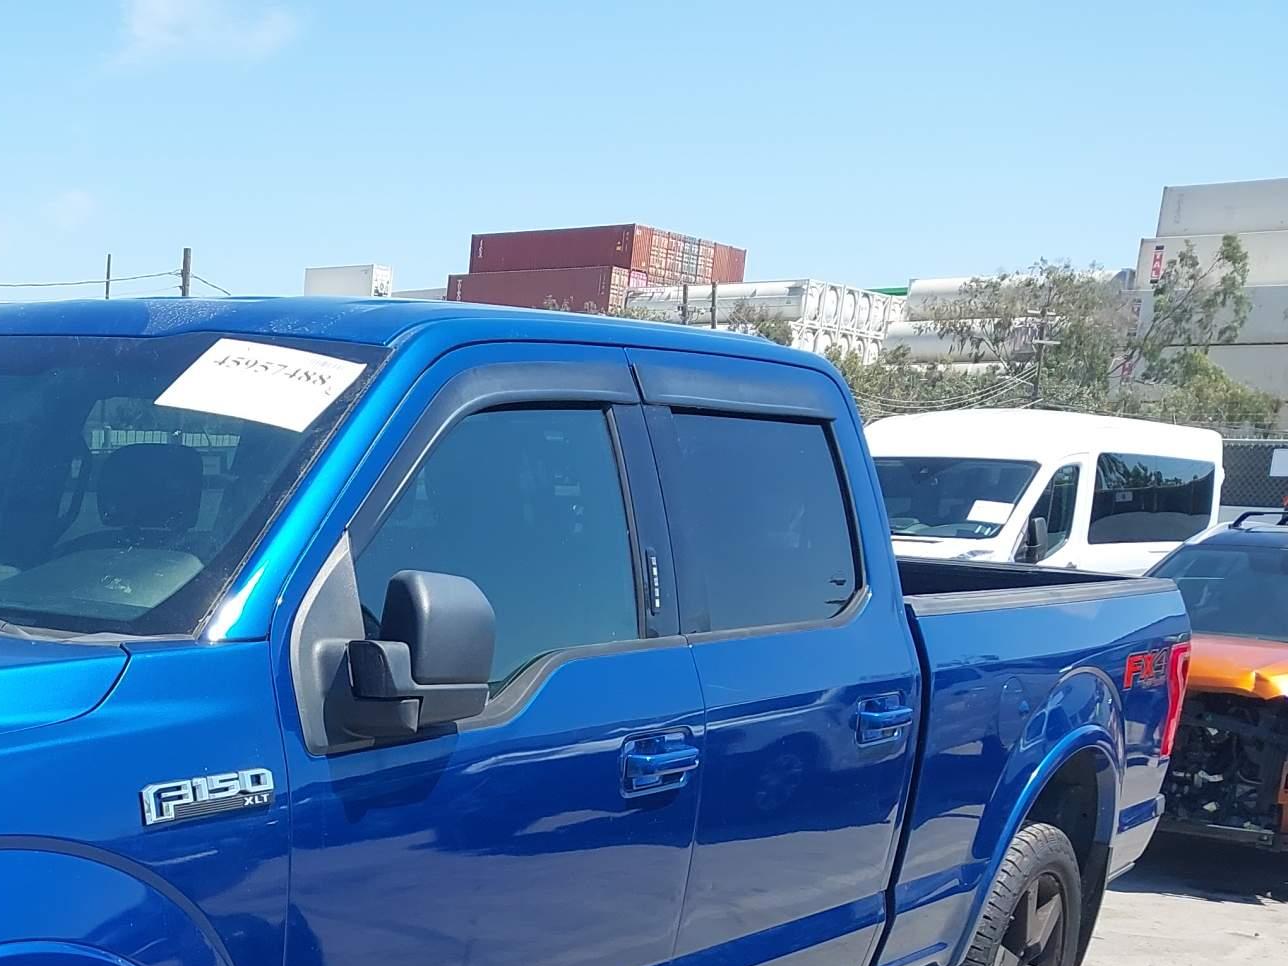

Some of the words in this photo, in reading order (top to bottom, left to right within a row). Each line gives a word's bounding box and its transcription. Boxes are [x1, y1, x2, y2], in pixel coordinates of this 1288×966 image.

[213, 354, 331, 386] 45957488
[1122, 646, 1171, 691] FX4
[243, 793, 270, 806] XLT
